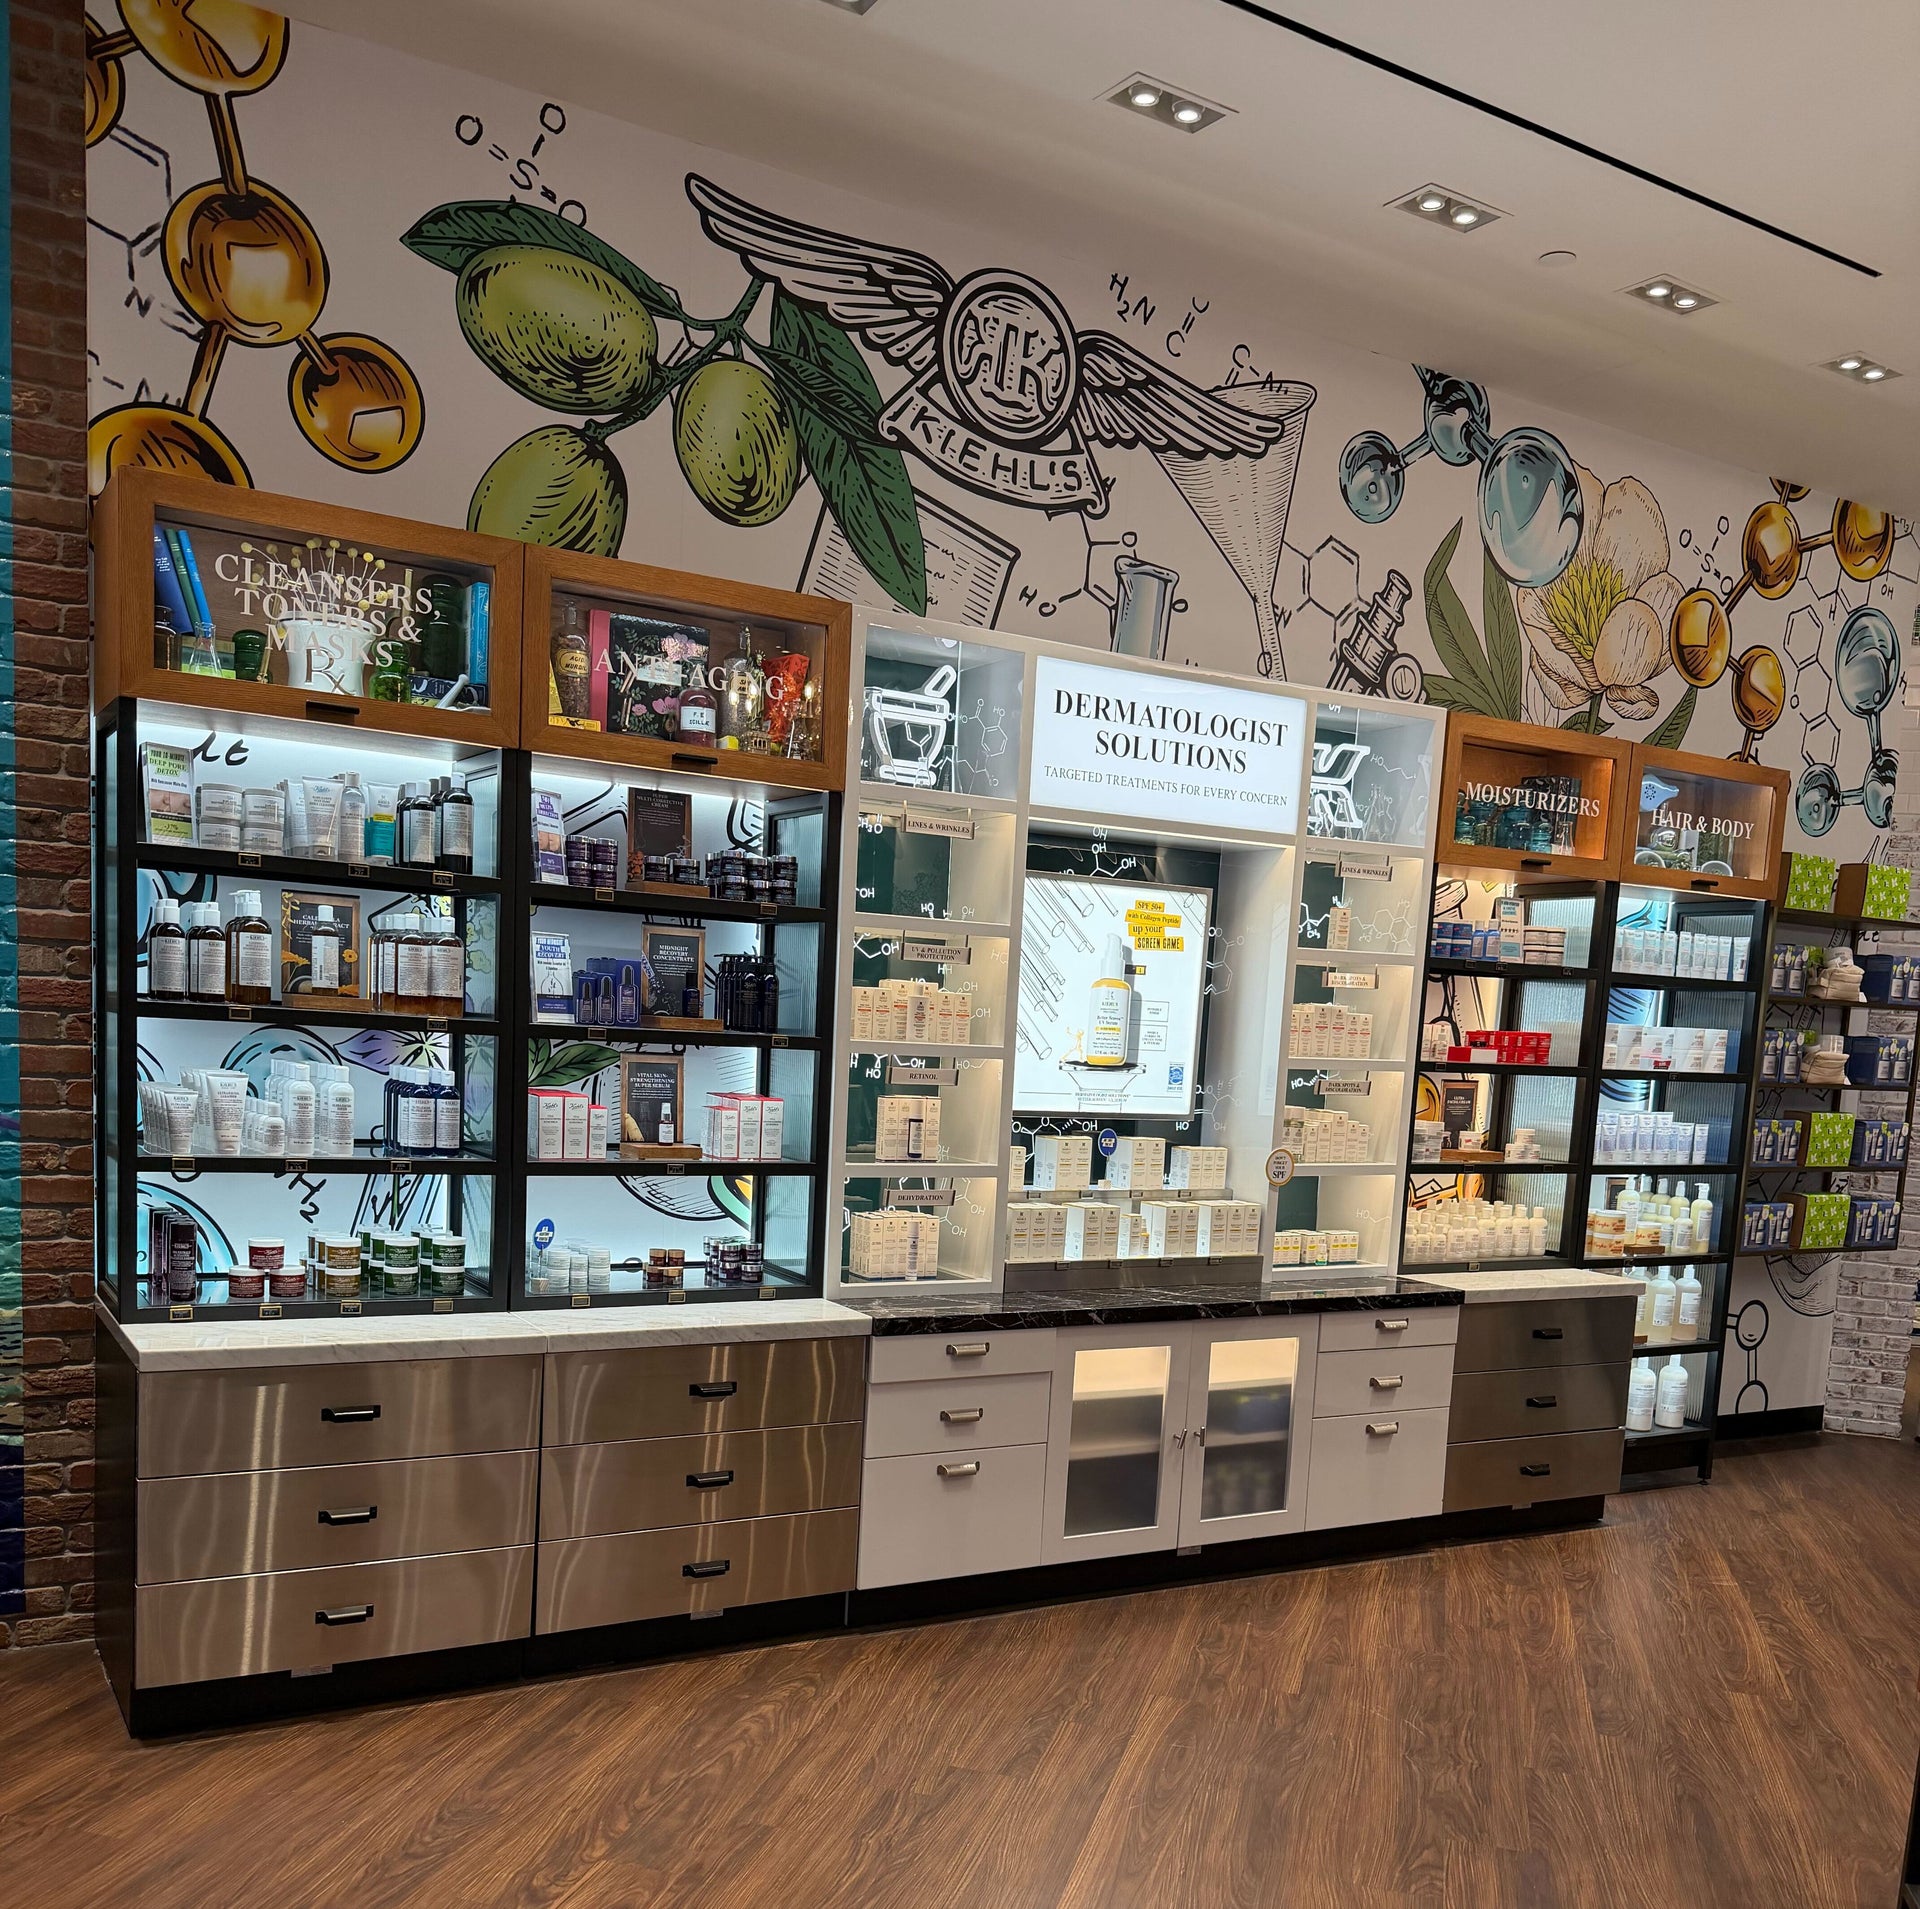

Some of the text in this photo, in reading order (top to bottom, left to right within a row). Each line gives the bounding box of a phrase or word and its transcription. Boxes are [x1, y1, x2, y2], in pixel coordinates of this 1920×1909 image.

[908, 405, 1083, 493] KIEHL'S
[215, 553, 443, 621] CLEANSERS,
[234, 587, 423, 644] TONERS &
[265, 622, 394, 668] MASKS
[594, 648, 785, 701] ANTI-AGING
[1053, 688, 1289, 748] DERMATOLOGIST
[1095, 731, 1248, 775] SOLUTIONS
[1043, 765, 1288, 807] TARGETED TREATMENTS FOR EVERY CONCERN
[1465, 782, 1600, 818] MOISTURIZERS
[908, 820, 928, 829] LINES
[935, 823, 970, 834] WRINKLES
[1652, 808, 1755, 841] HAIR & BODY
[1133, 925, 1162, 935] up your
[1137, 938, 1180, 950] SCREEN GAME
[1272, 1170, 1287, 1179] SPF
